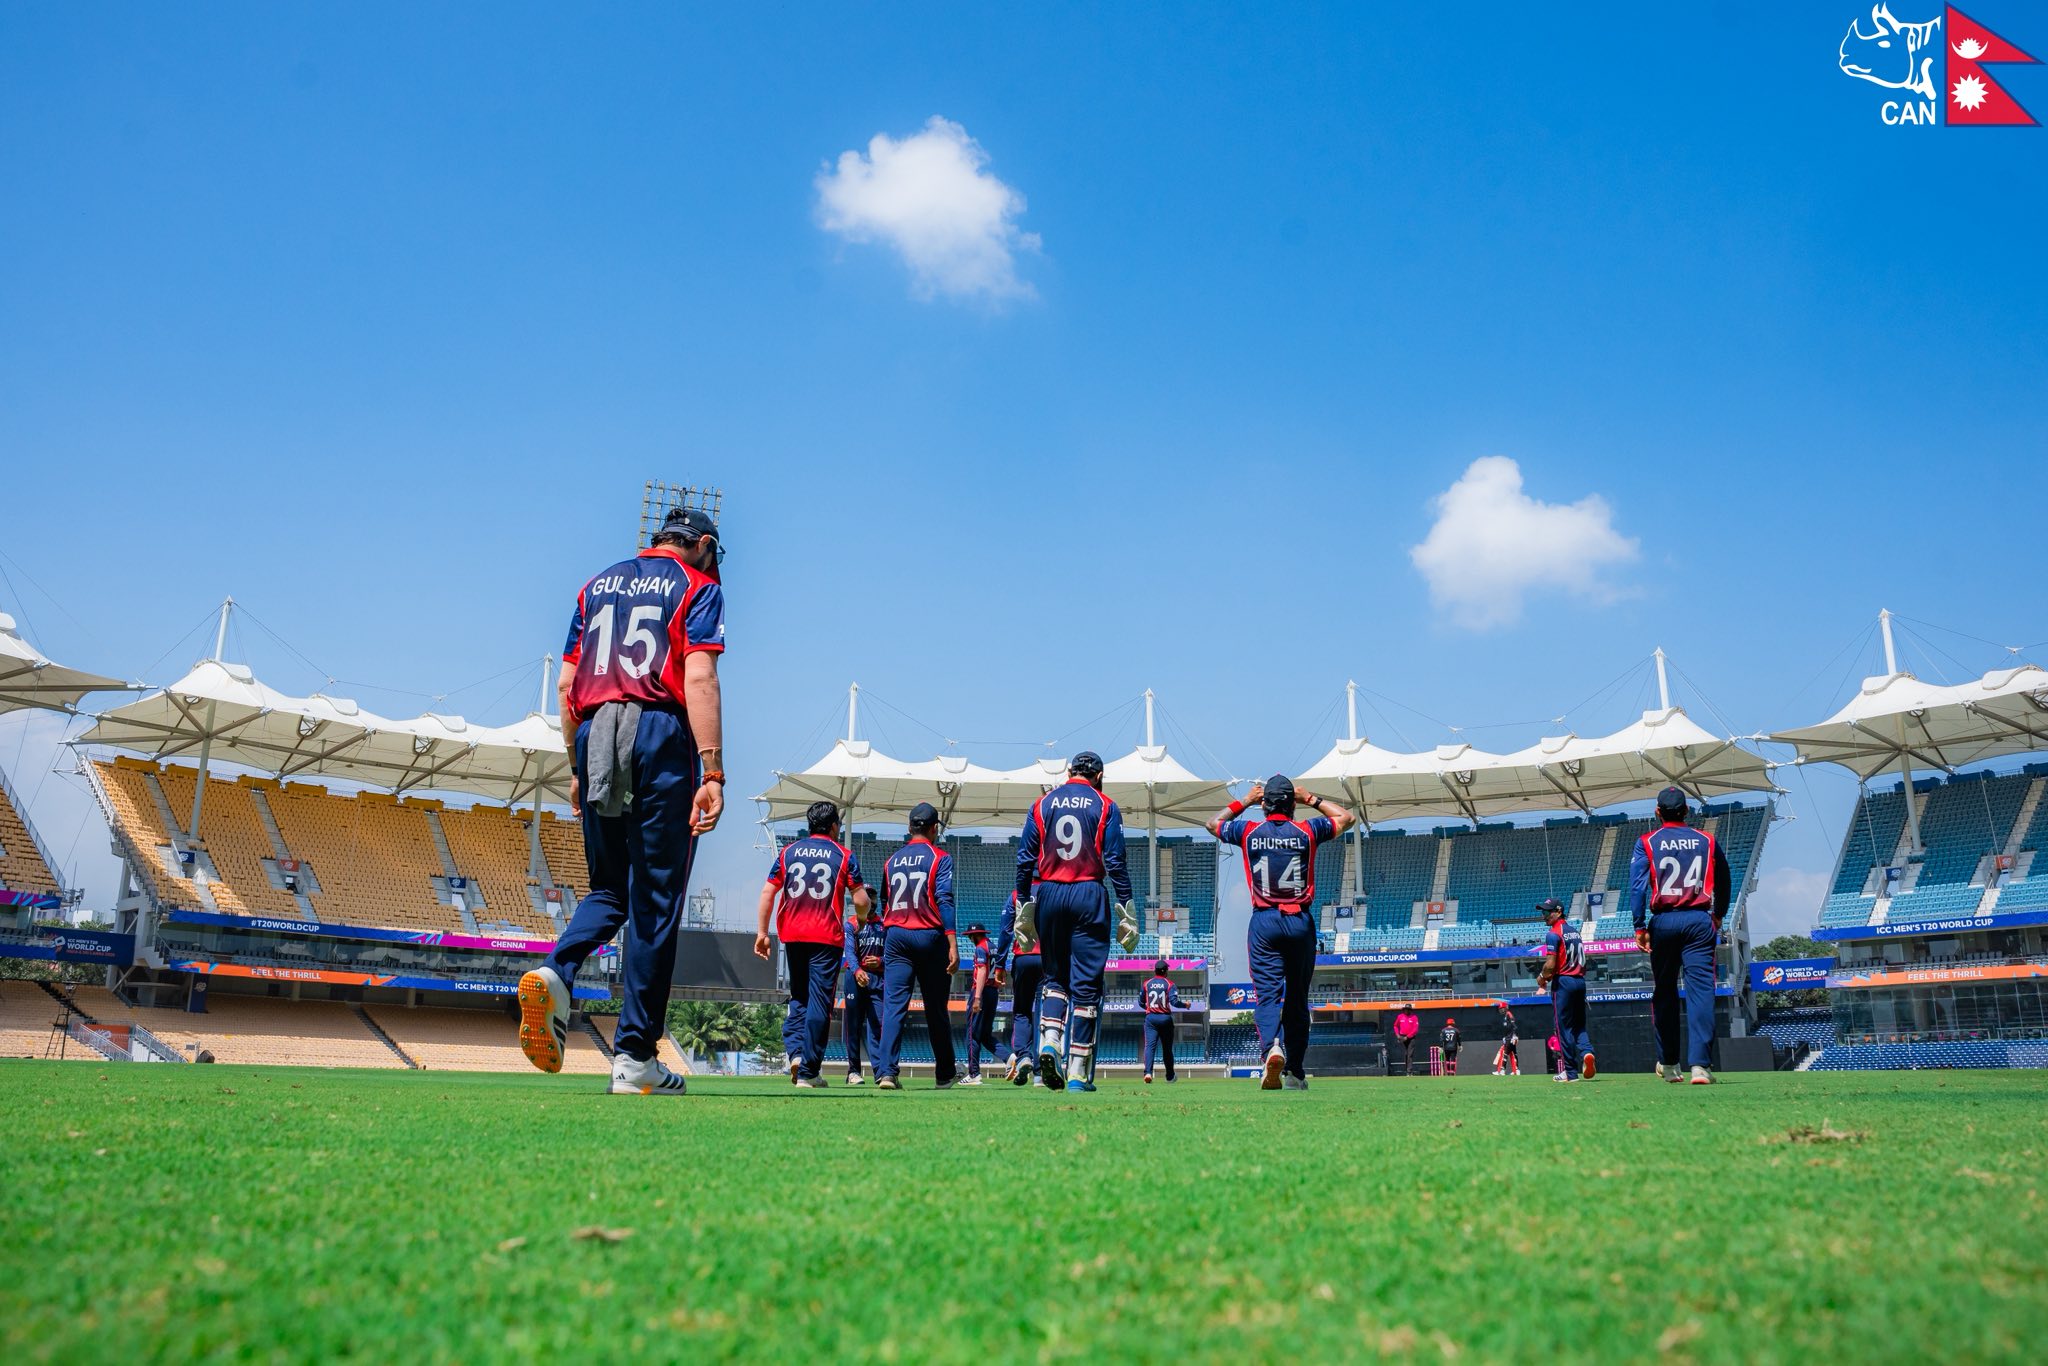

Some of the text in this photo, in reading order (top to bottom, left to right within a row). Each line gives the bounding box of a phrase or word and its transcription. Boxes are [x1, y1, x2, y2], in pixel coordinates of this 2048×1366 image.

[592, 576, 676, 597] GULSHAN
[588, 604, 662, 679] 15
[1051, 797, 1093, 809] AASIF
[1055, 815, 1082, 861] 9
[1251, 837, 1305, 850] BHURTEL
[1660, 839, 1700, 851] AARIF
[794, 847, 832, 859] KARAN
[893, 855, 925, 868] LALIT
[787, 862, 832, 900] 33
[1253, 855, 1305, 897] 14
[1659, 855, 1703, 896] 24
[891, 871, 927, 911] 27
[251, 919, 320, 932] #T20WORLDCUP
[1876, 918, 1994, 935] ICC MEN'S T20 WORLD CUP
[67, 942, 96, 951] WORLD
[491, 940, 526, 949] CHENNAI
[1584, 944, 1604, 952] FEEL
[1342, 954, 1418, 963] T20WORLDCUP.COM
[251, 968, 322, 980] FEEL THE THRILL
[1813, 969, 1828, 977] CUP
[1908, 970, 1984, 981] FEEL THE THRILL
[455, 982, 469, 990] ICC
[470, 983, 494, 991] MEN'S
[495, 985, 509, 993] T20
[1148, 991, 1166, 1008] 21
[1445, 1033, 1455, 1042] 37
